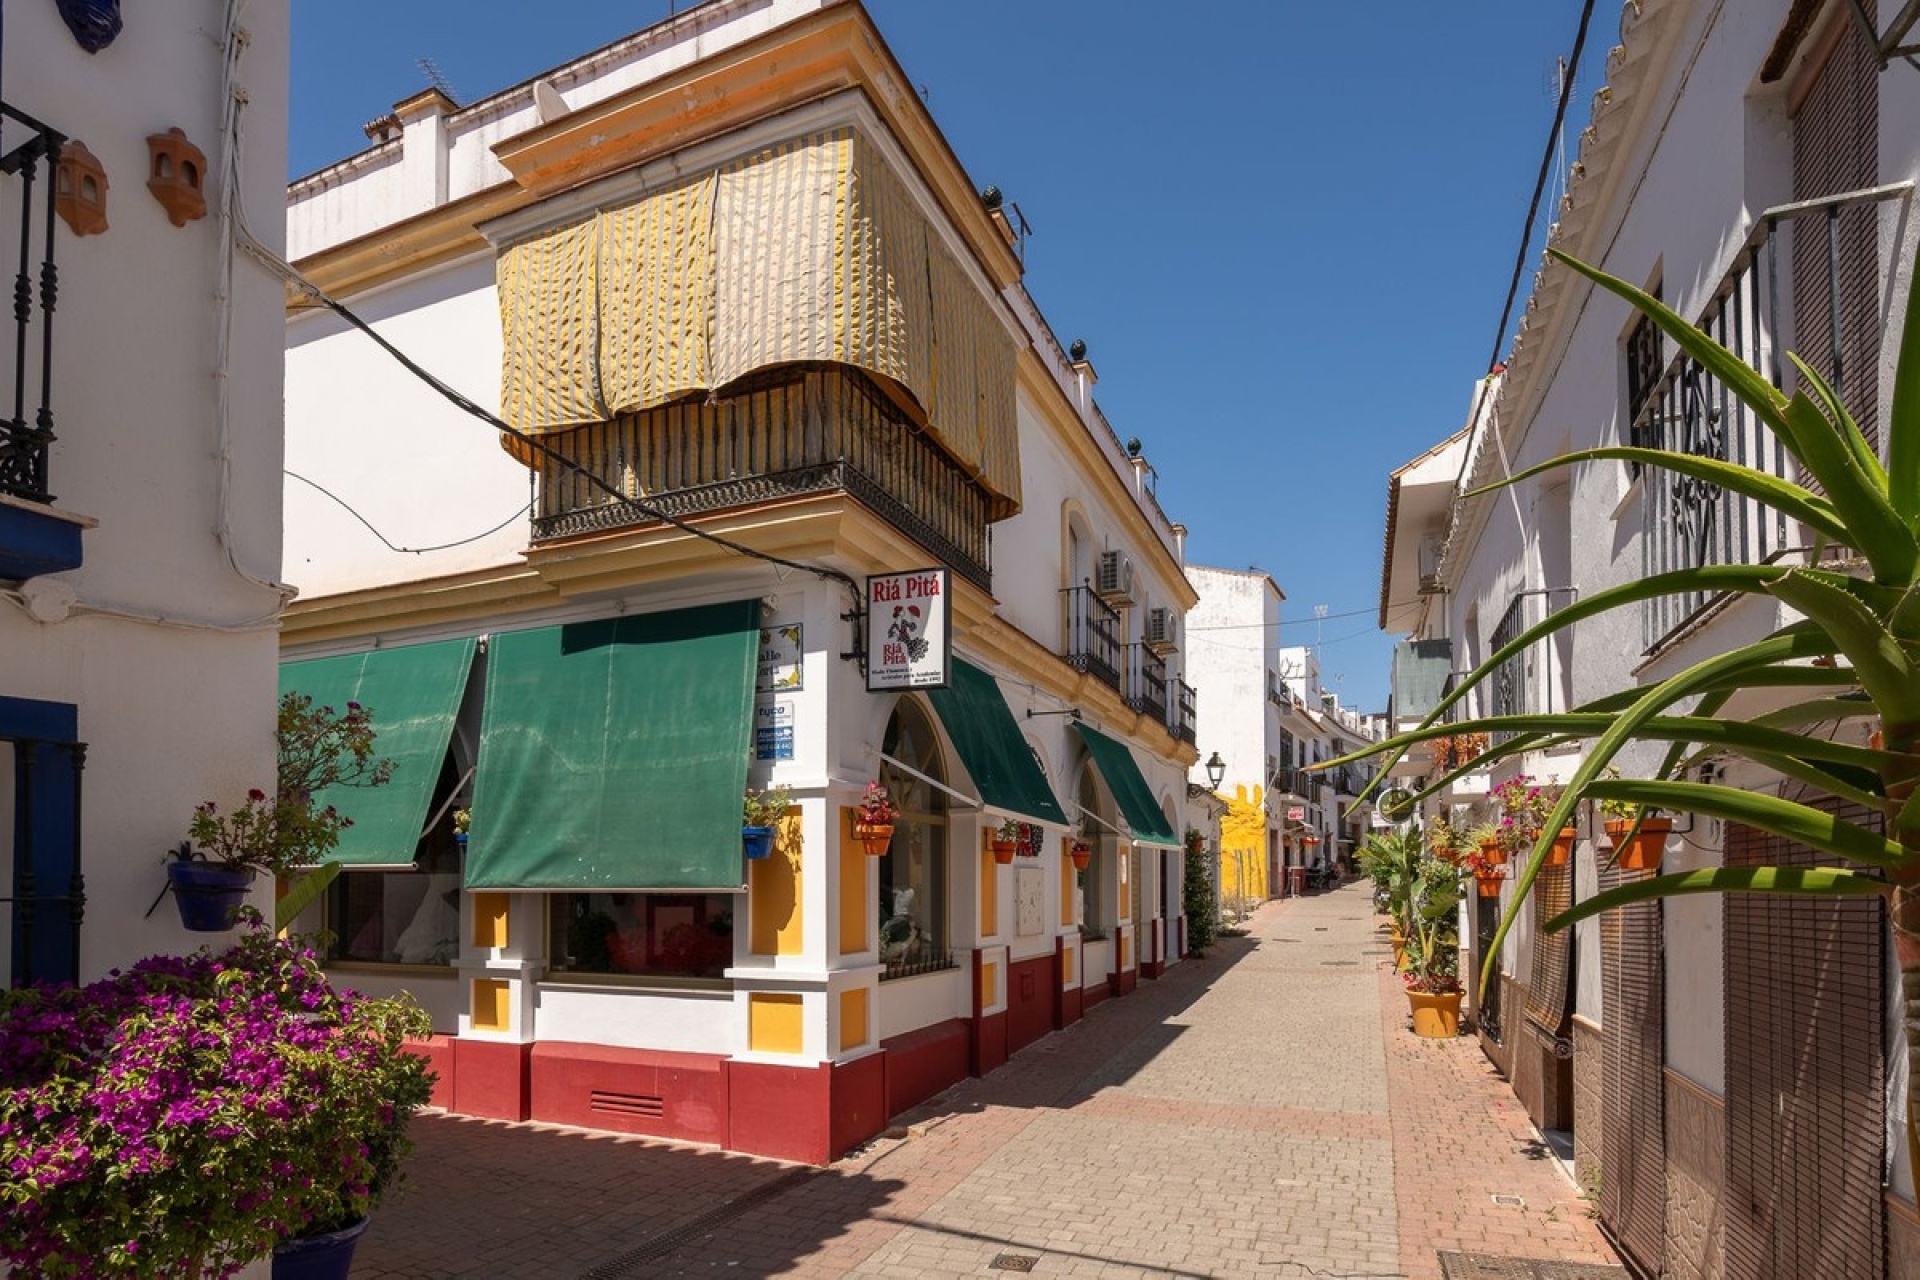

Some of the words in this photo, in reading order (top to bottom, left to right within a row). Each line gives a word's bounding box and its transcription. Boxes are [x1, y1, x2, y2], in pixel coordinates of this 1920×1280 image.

[873, 578, 901, 602] Riá
[905, 573, 940, 599] Pitá
[883, 653, 906, 665] Pitá
[760, 706, 785, 718] tyco
